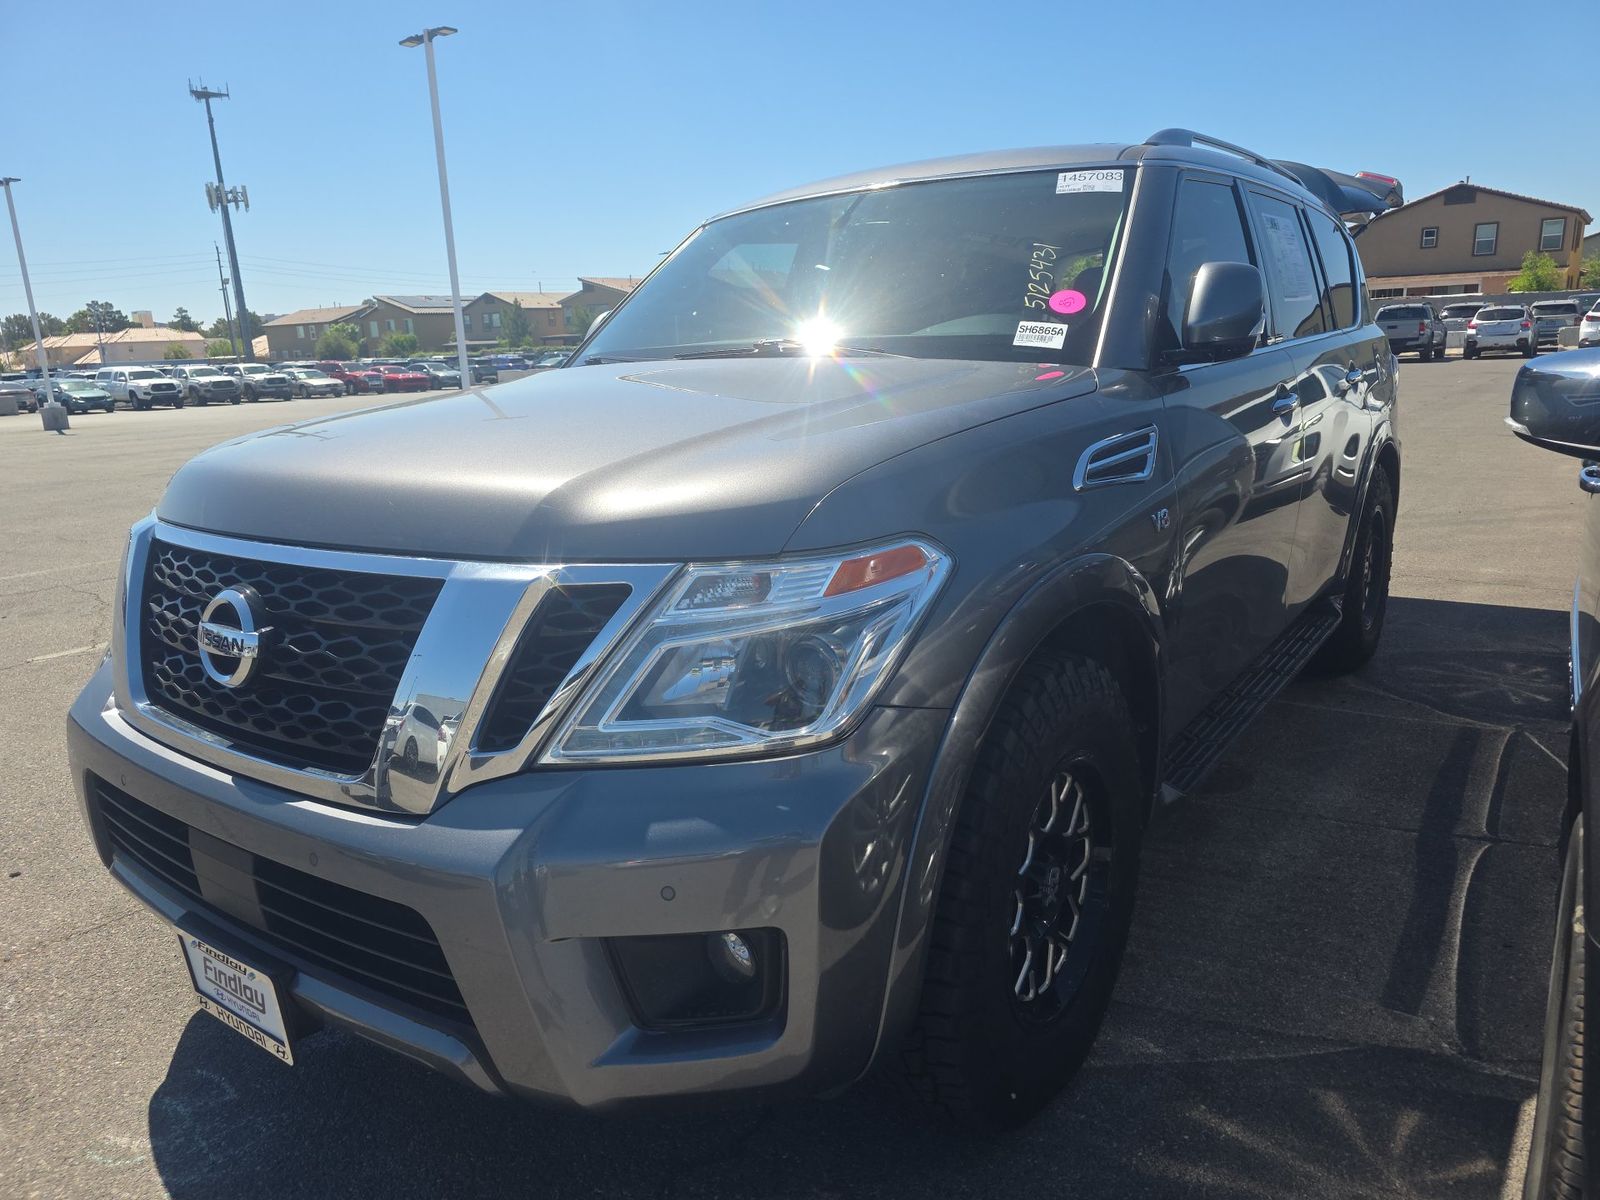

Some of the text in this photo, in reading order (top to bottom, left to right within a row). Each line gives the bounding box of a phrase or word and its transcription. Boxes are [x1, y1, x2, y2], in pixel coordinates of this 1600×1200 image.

[1062, 172, 1123, 182] 1457083
[1018, 325, 1064, 336] SH6865A
[197, 941, 248, 976] Findlay
[203, 956, 266, 1014] Findlay
[216, 1006, 267, 1048] HYUNDAI
